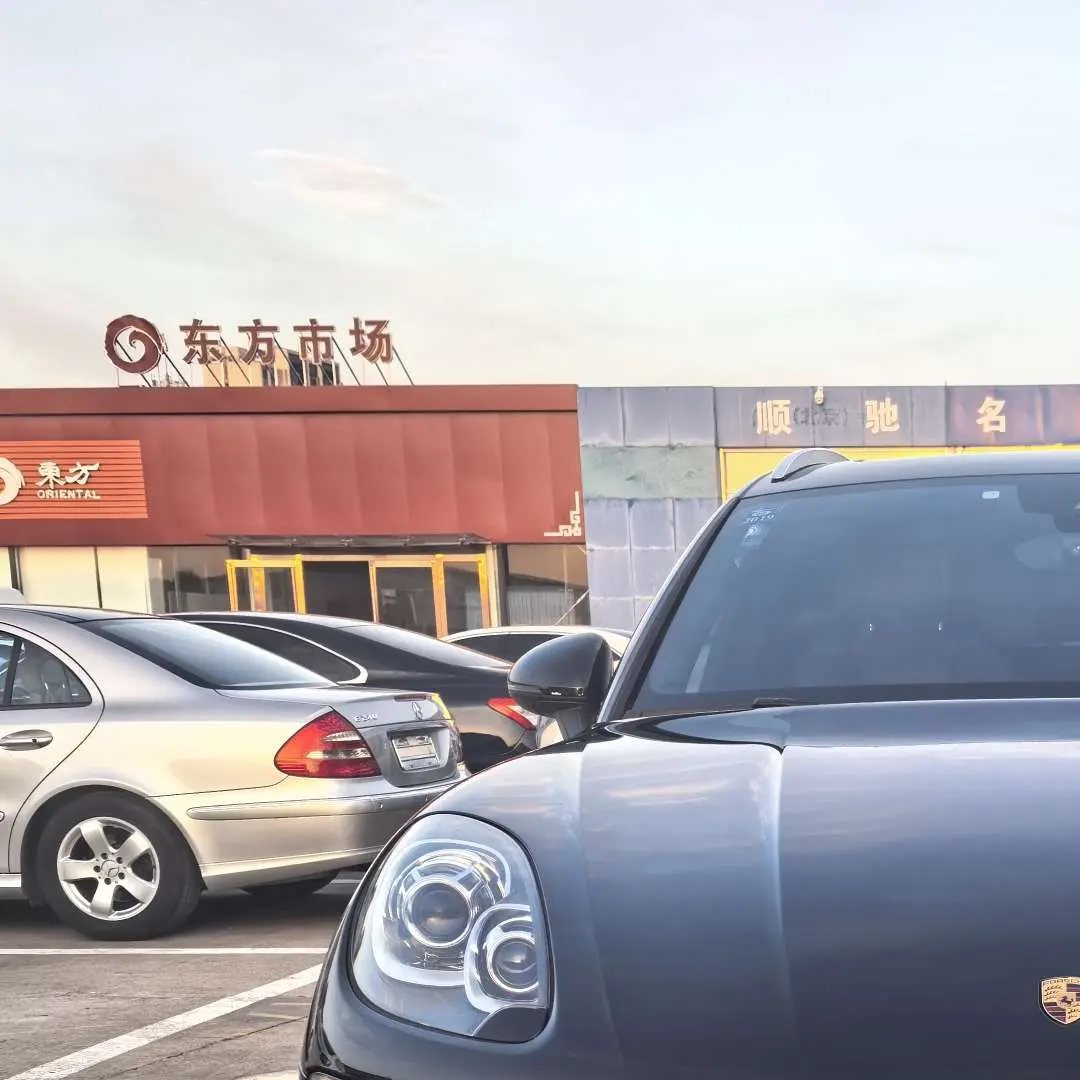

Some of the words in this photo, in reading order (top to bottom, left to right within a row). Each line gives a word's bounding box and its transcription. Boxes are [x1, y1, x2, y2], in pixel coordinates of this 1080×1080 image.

[179, 317, 393, 364] 东方市场
[37, 489, 102, 500] ORIENTAL
